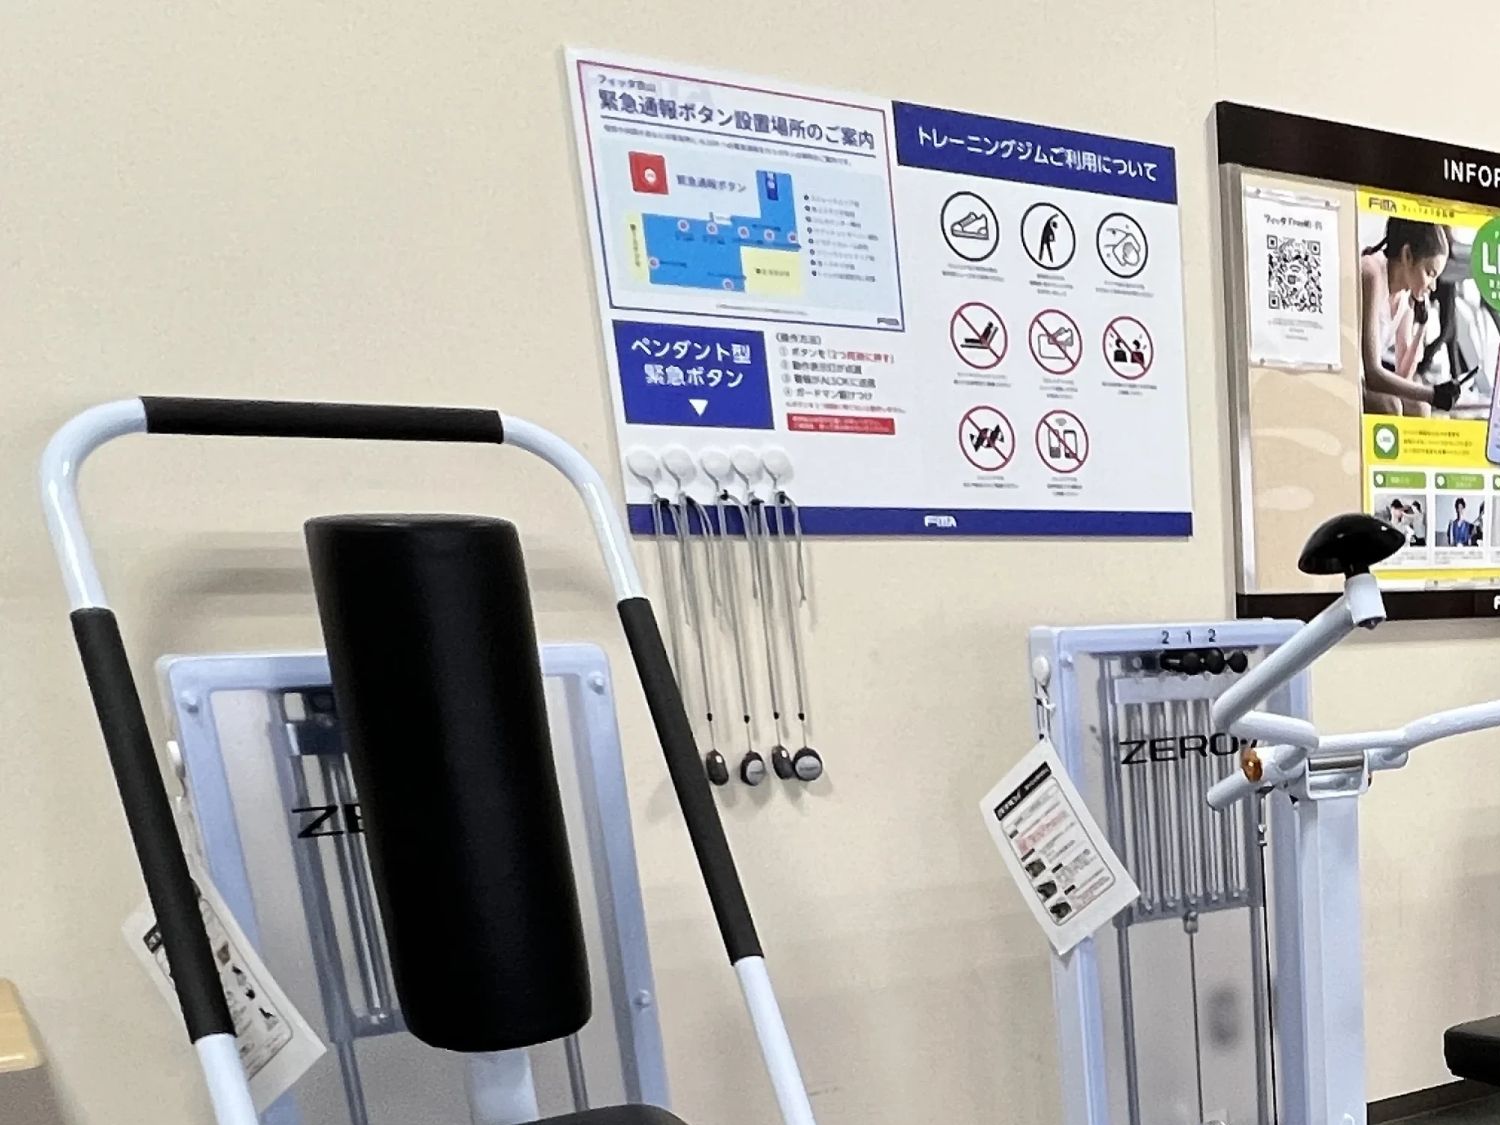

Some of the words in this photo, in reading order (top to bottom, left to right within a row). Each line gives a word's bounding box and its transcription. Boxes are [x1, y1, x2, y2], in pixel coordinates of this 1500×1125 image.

[599, 89, 875, 150] 緊急通報ボタン設置場所のご案内
[918, 125, 1157, 181] トレーニングジムご利用について
[631, 335, 752, 365] ペンダント型
[643, 363, 744, 388] 緊急ボタン
[1161, 630, 1170, 645] 2
[1185, 630, 1193, 644] 1
[1207, 628, 1217, 643] 2
